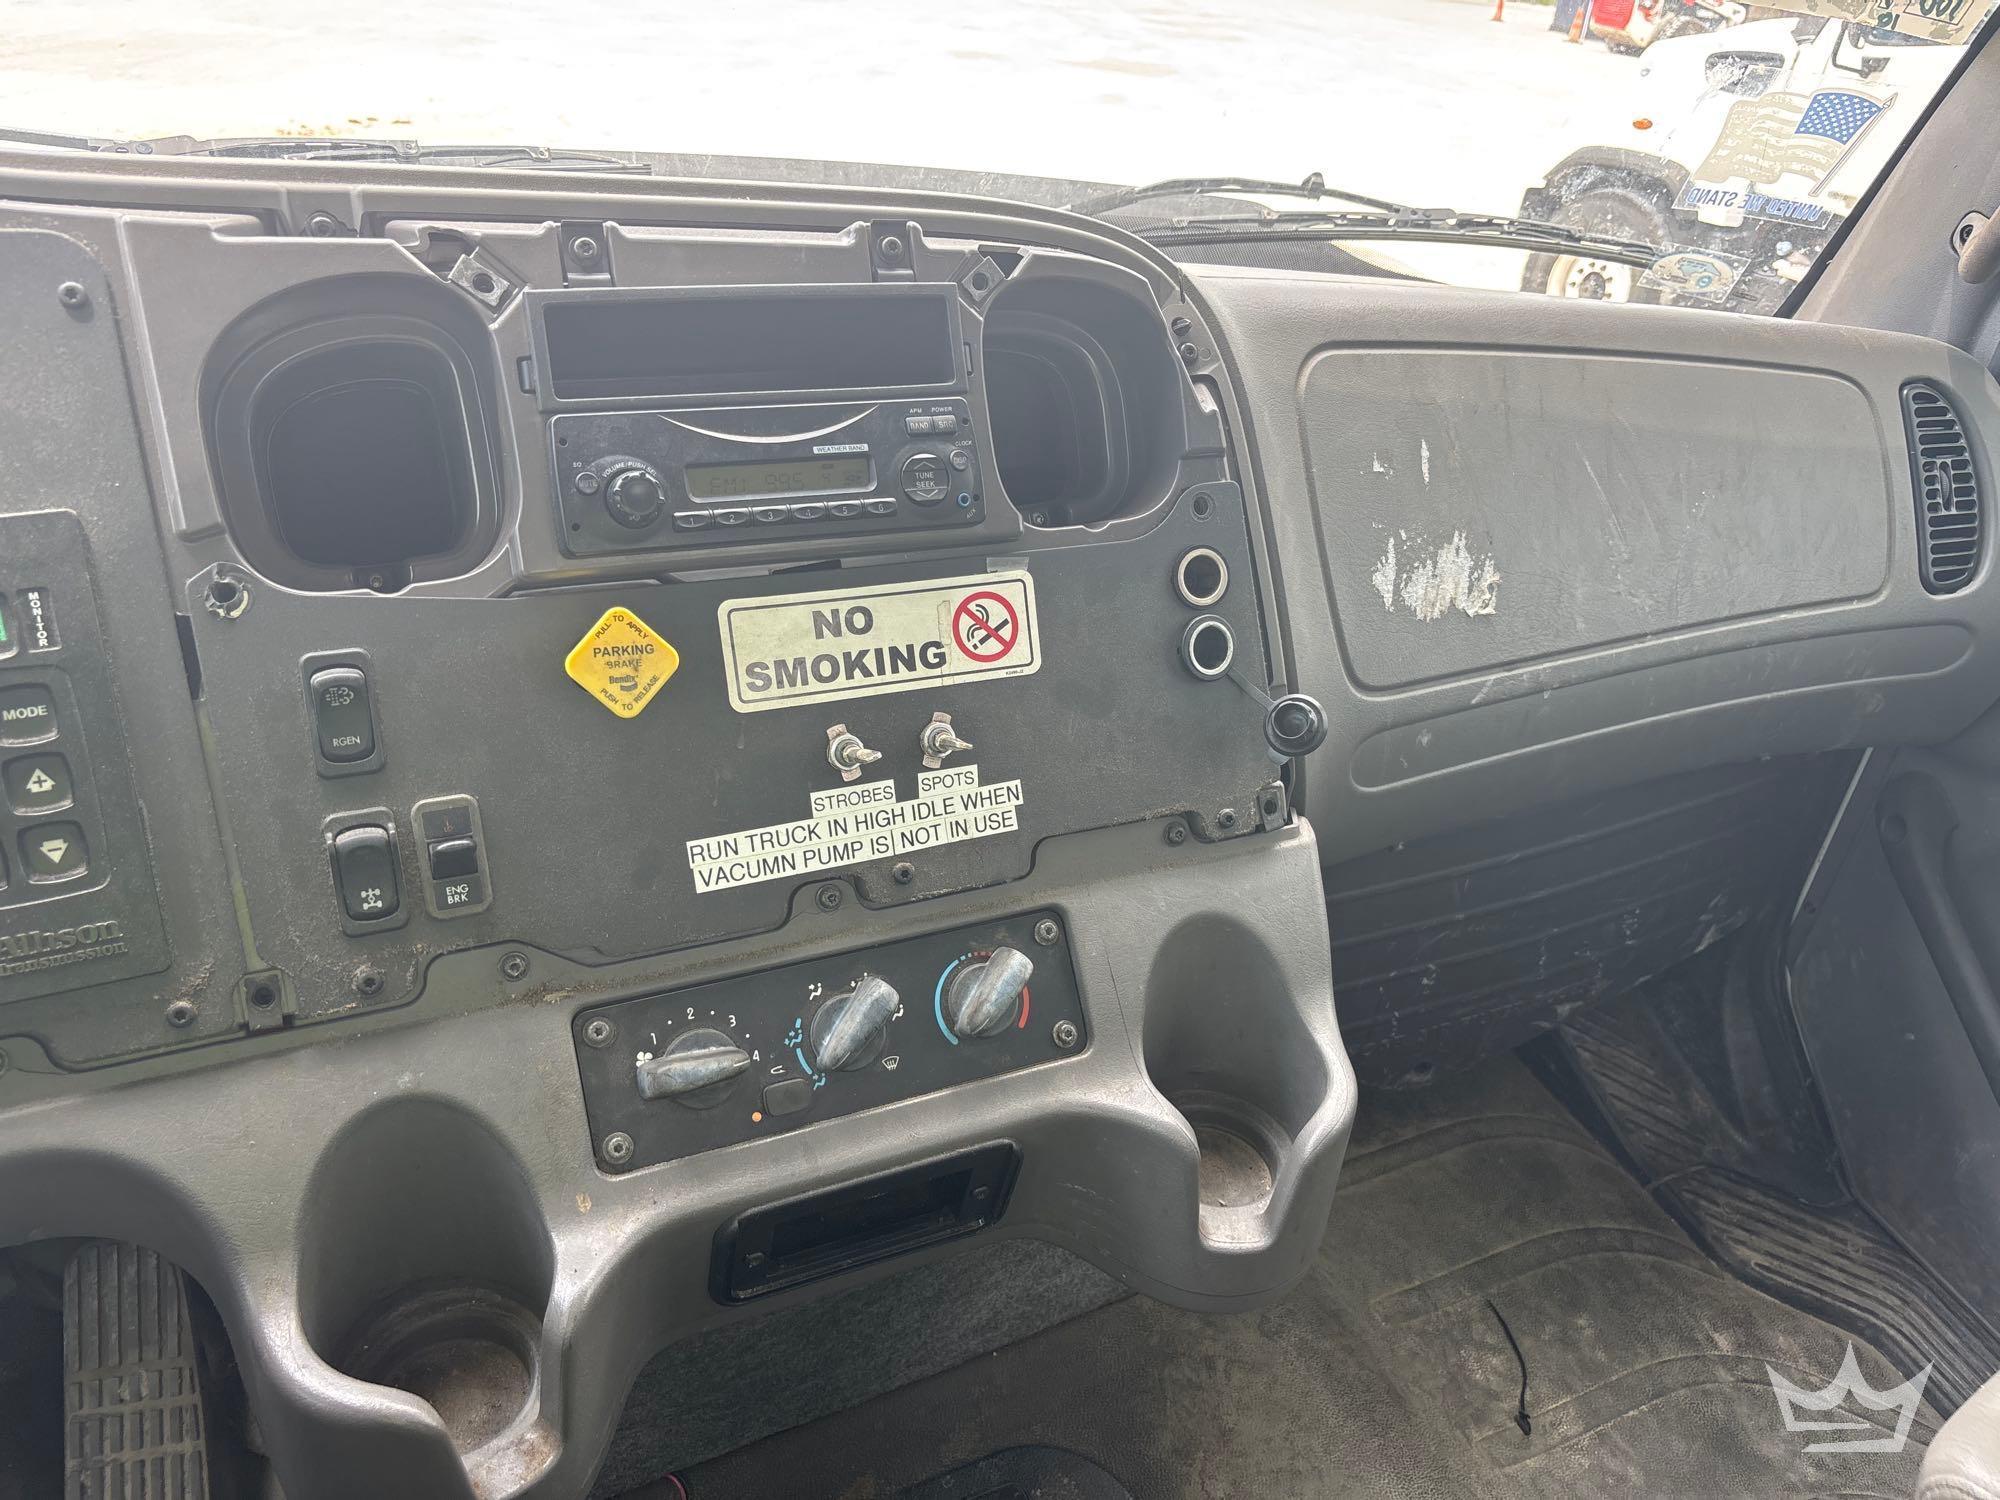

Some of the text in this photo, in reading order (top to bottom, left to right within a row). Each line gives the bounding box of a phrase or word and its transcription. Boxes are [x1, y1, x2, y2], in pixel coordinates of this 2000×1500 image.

[910, 421, 929, 429] BAND
[816, 444, 866, 453] WEATHER BAND
[915, 471, 934, 479] TUNE
[580, 480, 598, 488] MUTE
[915, 480, 936, 488] SEEK
[806, 509, 812, 517] 4
[842, 506, 848, 514] 5
[878, 503, 884, 512] 6
[966, 508, 976, 519] AUX
[690, 517, 695, 525] 1
[728, 514, 736, 522] 2
[767, 511, 774, 520] 3
[28, 591, 48, 646] MONITOR
[812, 605, 874, 640] NO
[595, 614, 649, 640] PULL TO APPLY
[593, 643, 655, 658] PARKING
[606, 658, 642, 670] BRAKE
[745, 640, 948, 692] SMOKING
[600, 674, 660, 711] PUSH TO RELEASE
[2, 704, 48, 720] MODE
[333, 736, 361, 747] RGEN
[921, 771, 975, 792] SPOTS
[813, 786, 894, 812] STROBES
[689, 785, 1021, 864] RUN TRUCK IN HIGH IDLE WHEN
[698, 809, 1015, 888] VACUMN PUMP IS NOT IN USE
[446, 883, 469, 895] ENG
[447, 892, 469, 904] BRK
[686, 1007, 695, 1020] 2
[728, 1015, 737, 1027] 3
[650, 1032, 657, 1045] 1
[752, 1049, 760, 1061] 4
